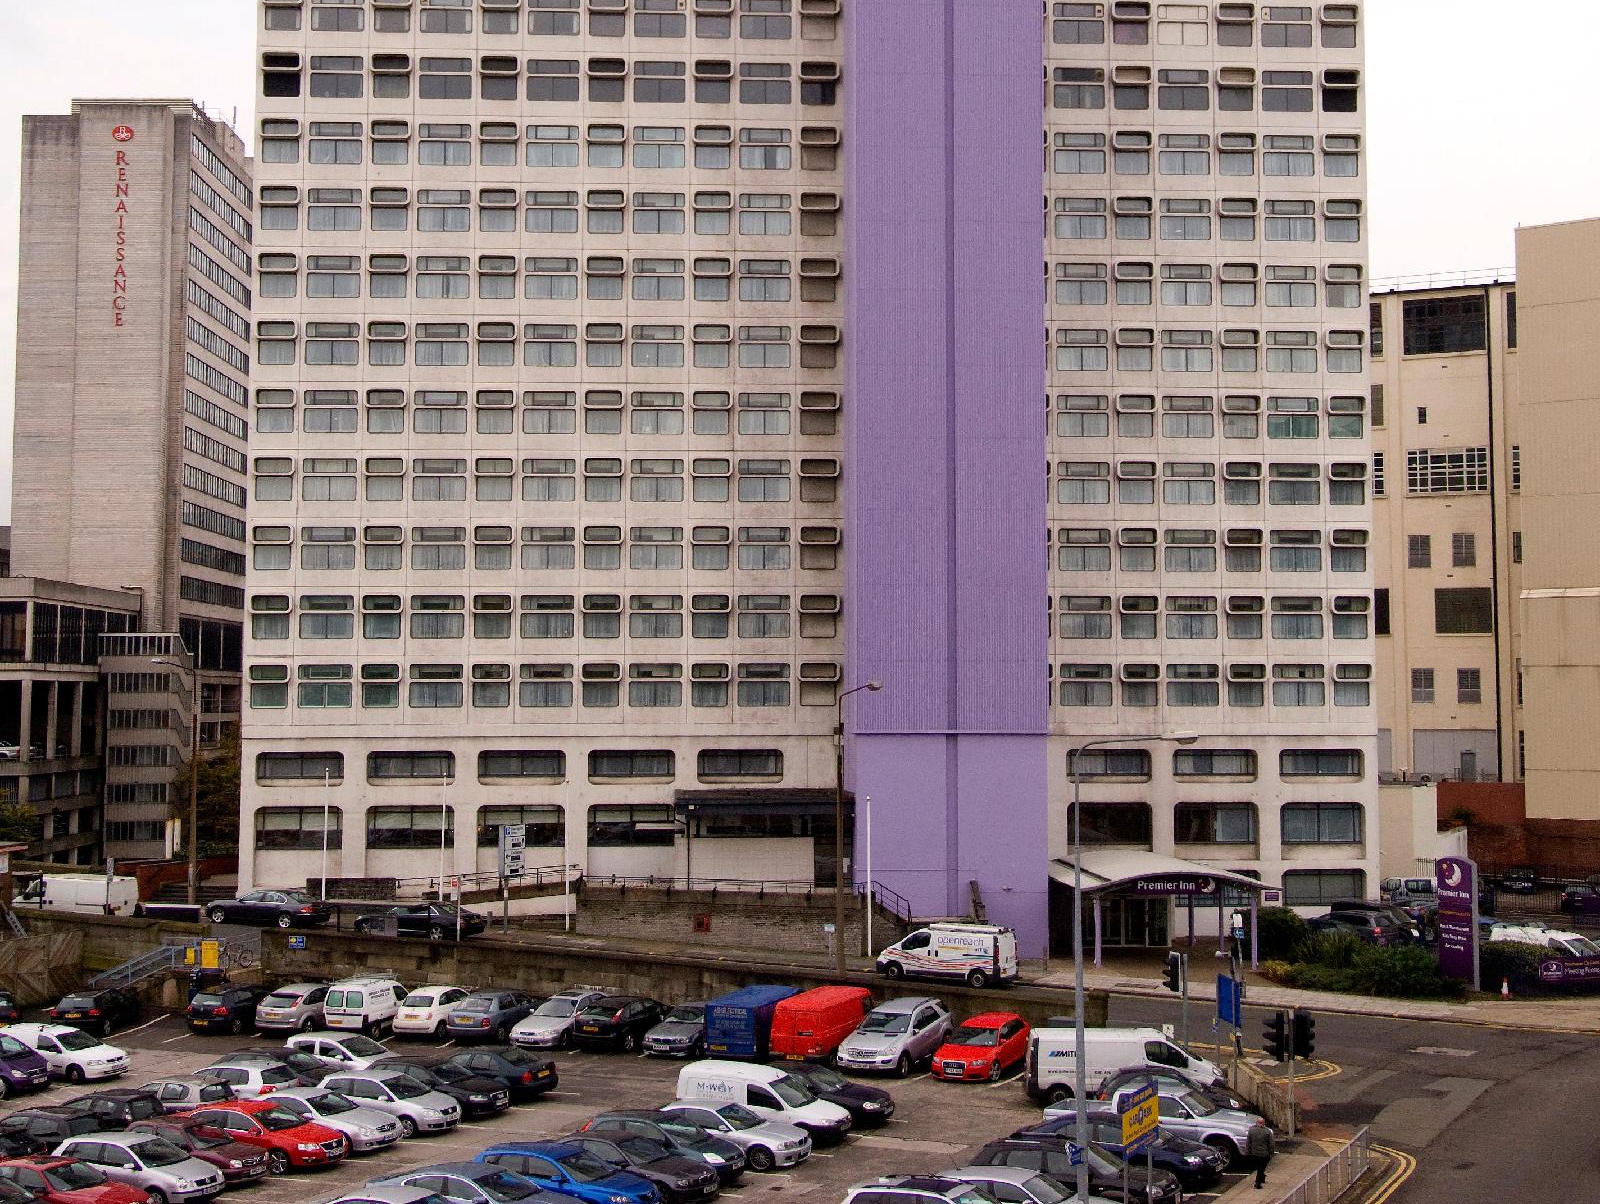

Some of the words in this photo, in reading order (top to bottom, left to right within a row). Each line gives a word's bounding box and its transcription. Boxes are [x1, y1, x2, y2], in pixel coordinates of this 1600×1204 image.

[113, 150, 130, 327] RENAISSANCE
[1137, 880, 1177, 890] Premier
[1179, 881, 1196, 890] Inn
[1437, 887, 1459, 898] Premier
[1459, 890, 1470, 899] Inn
[937, 936, 984, 946] openreach
